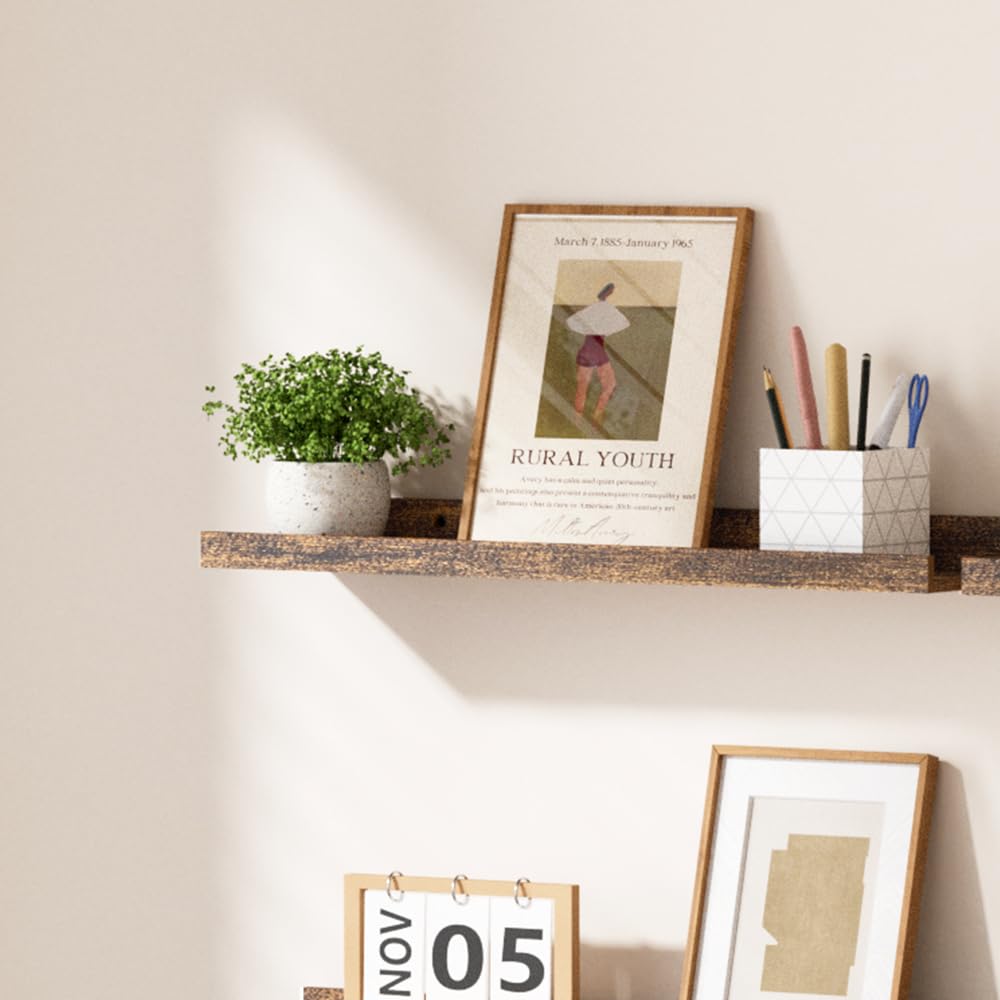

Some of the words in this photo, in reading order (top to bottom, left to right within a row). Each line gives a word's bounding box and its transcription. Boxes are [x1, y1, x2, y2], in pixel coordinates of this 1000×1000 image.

[554, 237, 588, 247] March
[672, 239, 694, 248] 1965
[511, 448, 589, 467] RURAL
[597, 451, 675, 469] YOUTH
[379, 908, 412, 997] NOV
